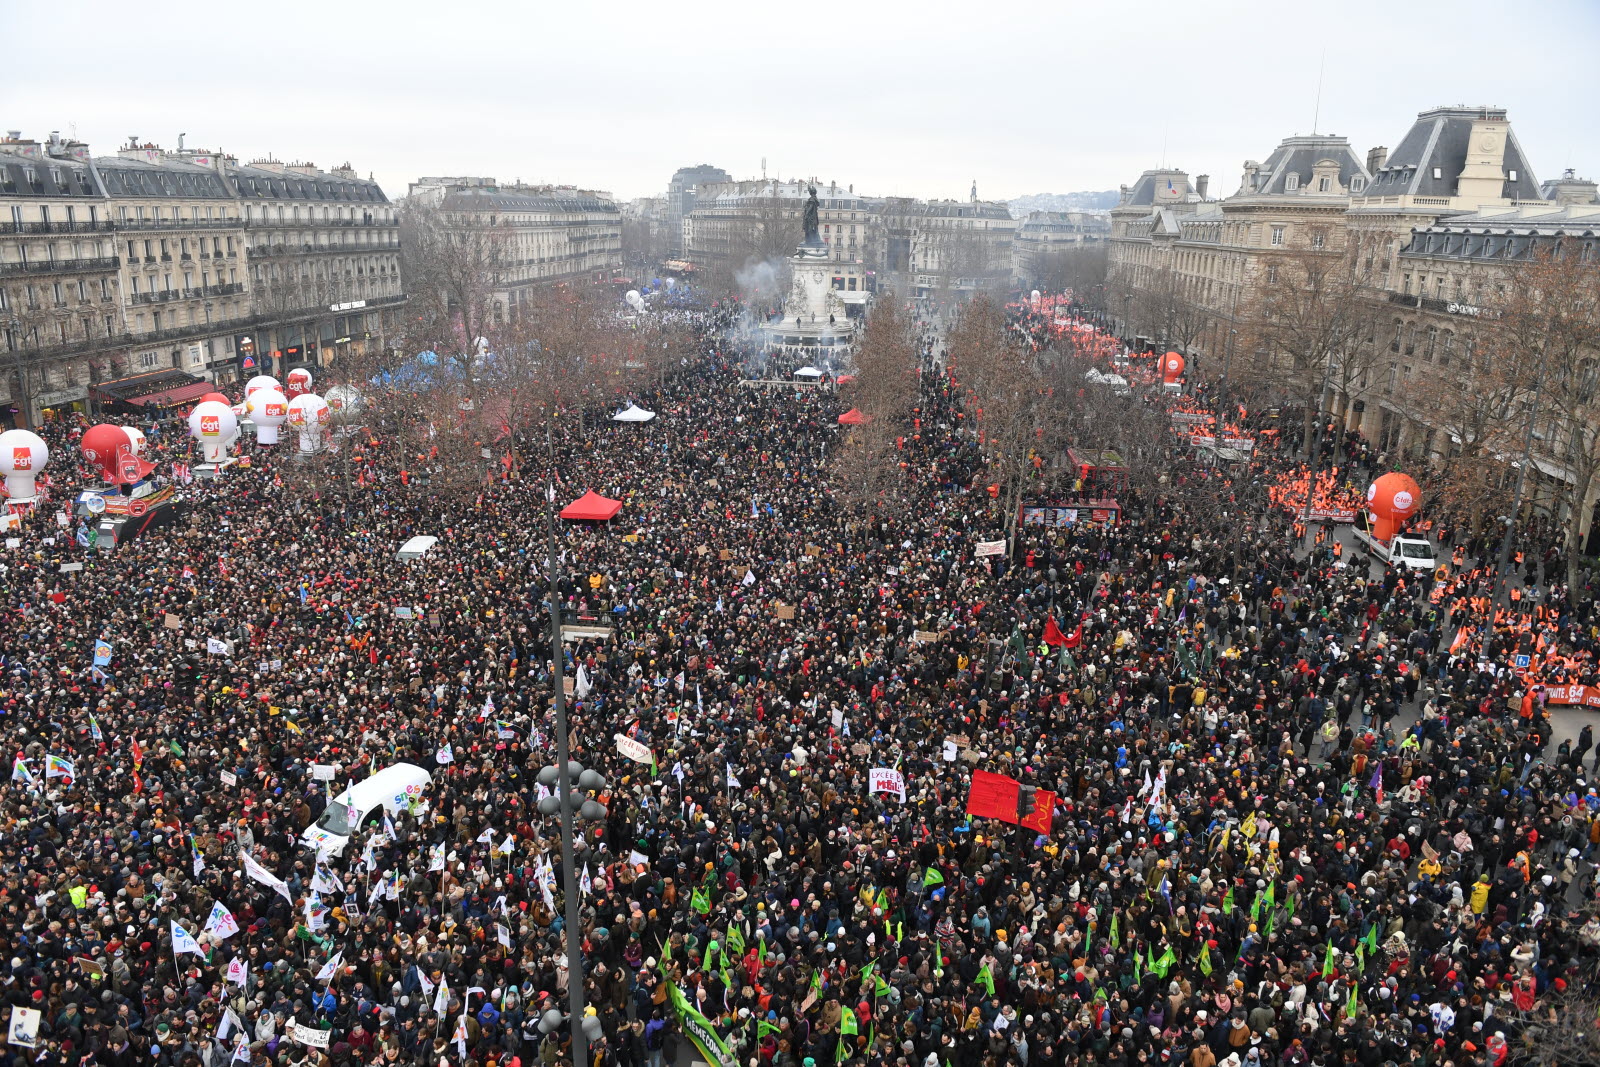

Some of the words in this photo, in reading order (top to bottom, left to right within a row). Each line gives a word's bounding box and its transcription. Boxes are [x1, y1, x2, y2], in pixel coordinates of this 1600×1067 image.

[289, 382, 301, 391] cgt
[267, 406, 280, 415] cgt
[201, 421, 220, 431] cgt
[14, 457, 32, 467] cgt
[1569, 685, 1584, 698] 64
[871, 771, 894, 780] LYCÉE
[394, 784, 421, 805] snes
